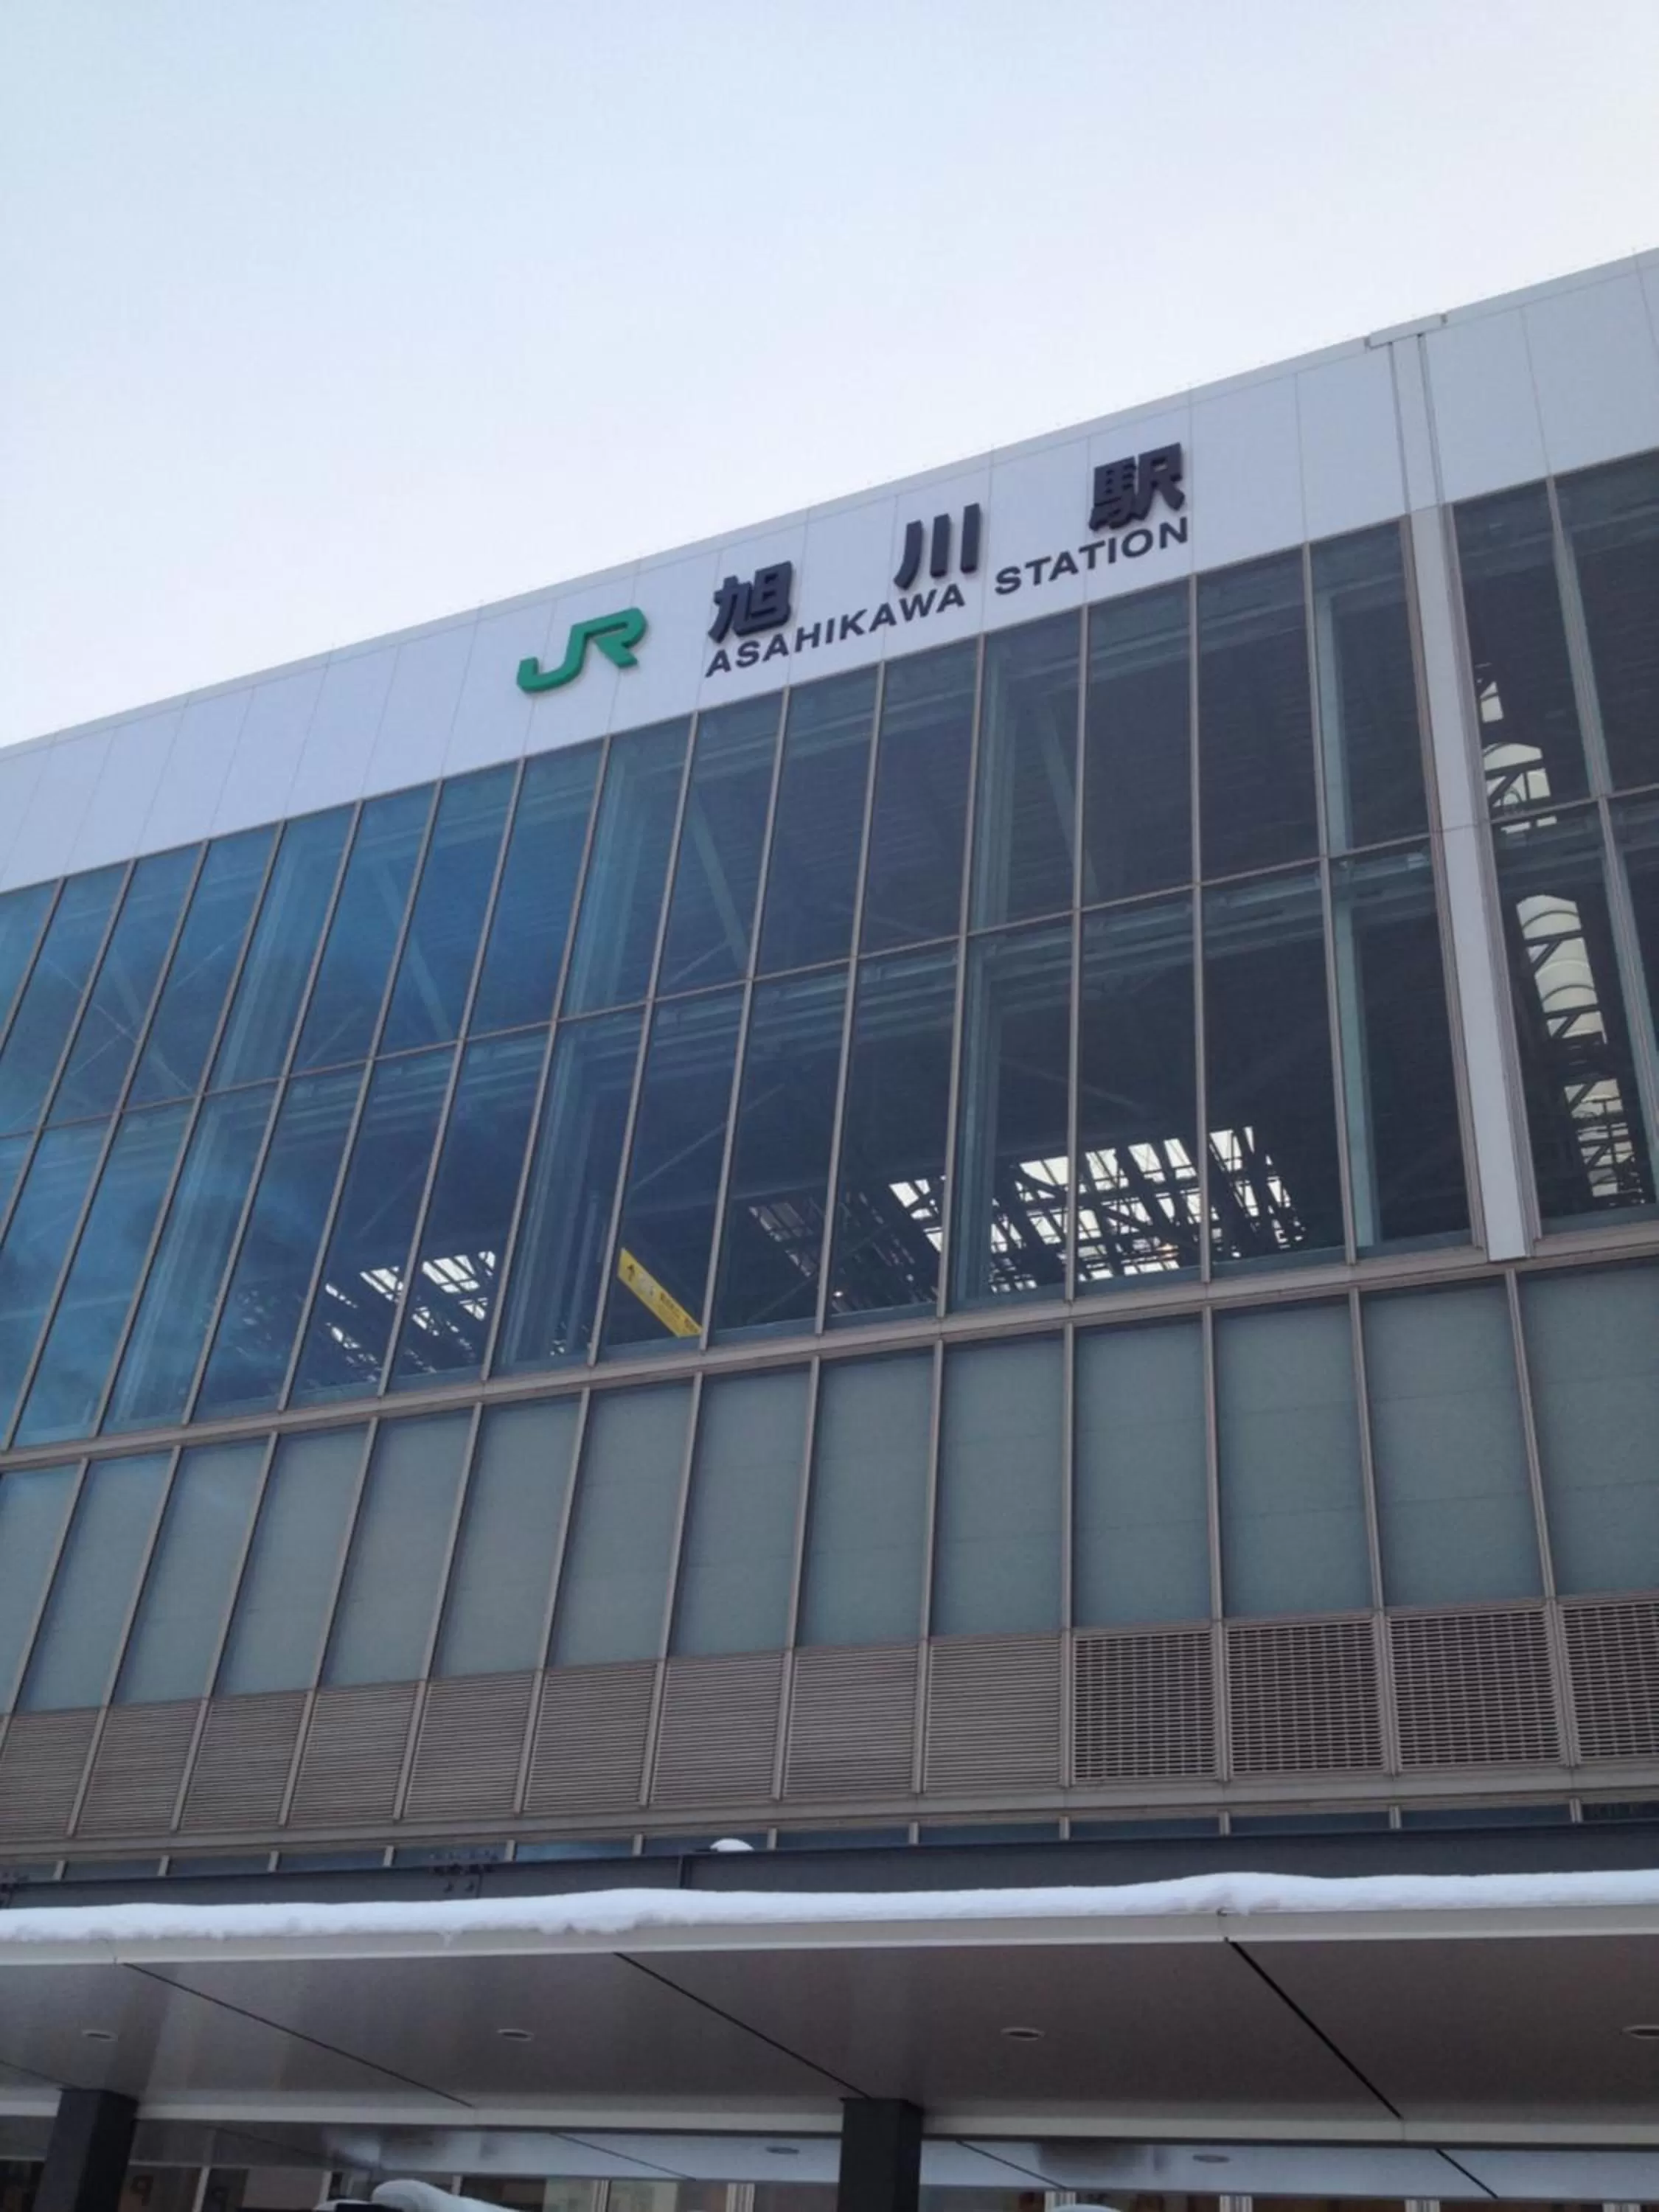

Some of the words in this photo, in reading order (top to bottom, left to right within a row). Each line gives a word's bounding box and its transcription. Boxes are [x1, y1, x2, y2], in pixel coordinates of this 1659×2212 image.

[517, 607, 647, 692] JR
[706, 583, 966, 678] ASAHIKAWA
[995, 517, 1188, 594] STATION
